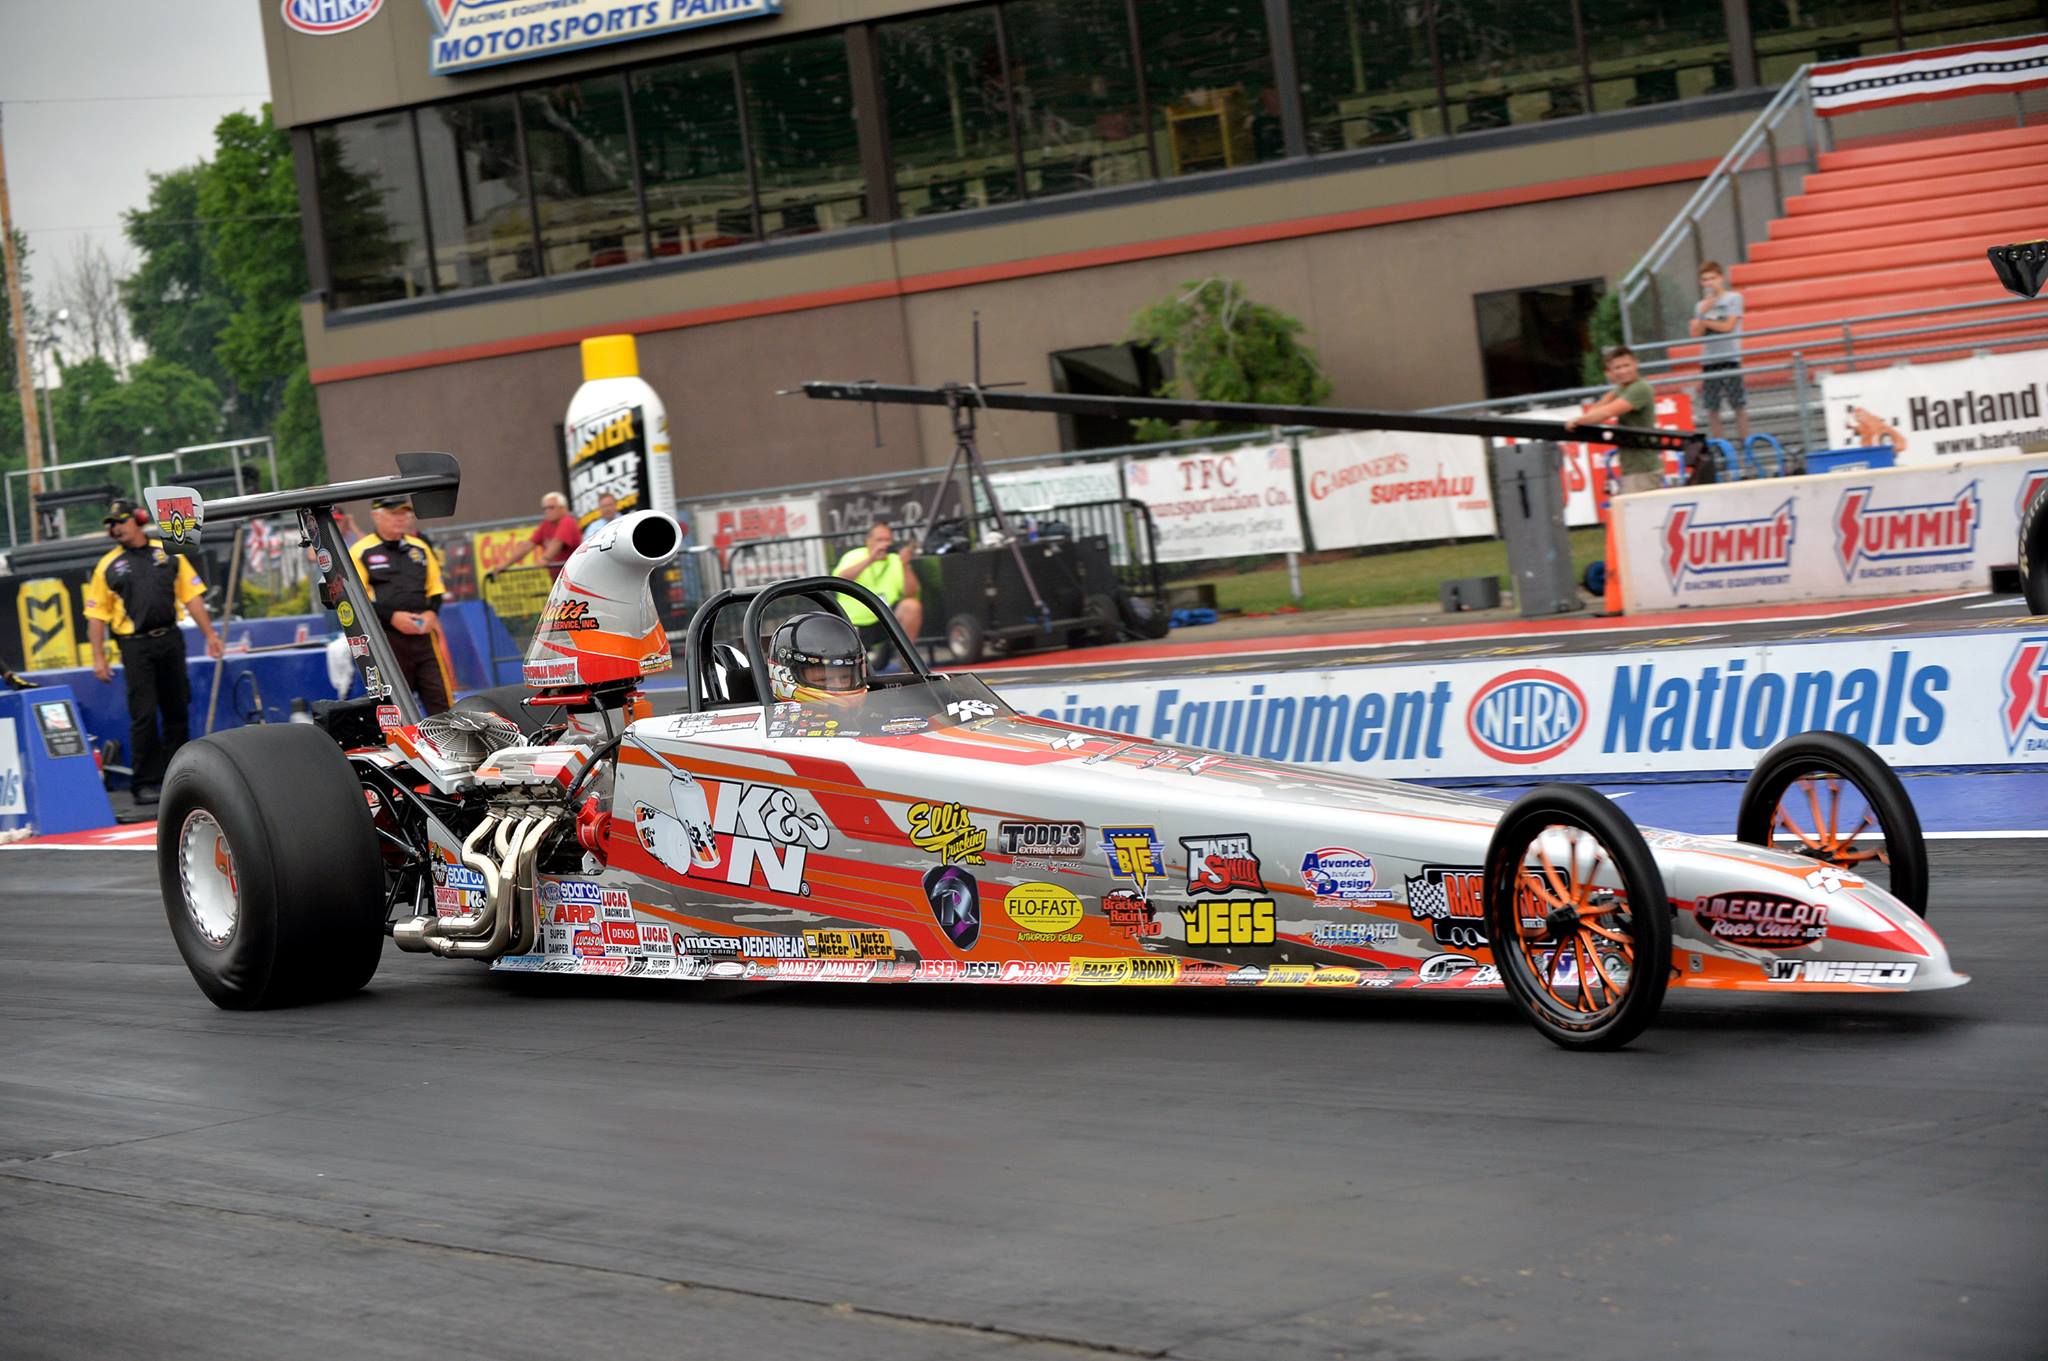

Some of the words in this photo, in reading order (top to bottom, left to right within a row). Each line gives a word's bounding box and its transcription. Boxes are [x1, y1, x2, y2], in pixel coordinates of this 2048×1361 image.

[437, 2, 660, 65] MOTORSPORTS
[1908, 382, 2041, 431] Harland
[1178, 454, 1238, 492] TFC
[1859, 565, 1901, 578] RACING
[1905, 560, 1974, 575] EQUIPMENT
[1684, 578, 1724, 592] RACING
[1727, 574, 1791, 589] EQUIPMENT
[581, 619, 598, 629] INC.
[1486, 685, 1570, 749] NHRA
[1602, 651, 1950, 754] Nationals
[907, 801, 971, 836] Ellis
[1003, 824, 1081, 854] TODD'S
[1056, 847, 1081, 855] PAINT
[965, 854, 986, 865] INC.
[1300, 853, 1371, 872] Advanced
[561, 882, 600, 899] sparco
[1317, 879, 1371, 895] Design
[602, 892, 627, 908] LUCAS
[1009, 899, 1078, 916] FLO-FAST
[1103, 899, 1148, 911] Bracket
[554, 904, 596, 923] ARP
[1111, 910, 1148, 922] Racing
[1695, 897, 1828, 925] AMERICAN
[1186, 901, 1275, 944] JEGS
[1711, 918, 1750, 937] Race
[549, 929, 566, 939] SUPER
[613, 929, 635, 939] DENSO
[642, 927, 668, 941] LUCAS
[818, 932, 842, 944] Auto
[860, 932, 885, 944] Auto
[548, 944, 569, 954] DAMPER
[606, 946, 623, 954] SPARK
[624, 946, 642, 954] PLUGS
[685, 937, 743, 950] MOSER
[743, 936, 805, 957] DEDENBEAR
[818, 944, 849, 956] Meter
[861, 944, 893, 956] Meter
[779, 961, 820, 976] MANLEY
[823, 961, 869, 976] MANLEY
[917, 961, 957, 977] JESEL
[960, 962, 1001, 978] JESEL
[1083, 963, 1125, 978] EARL'S
[1132, 959, 1175, 979] BRODIX
[1804, 961, 1918, 984] WISECO
